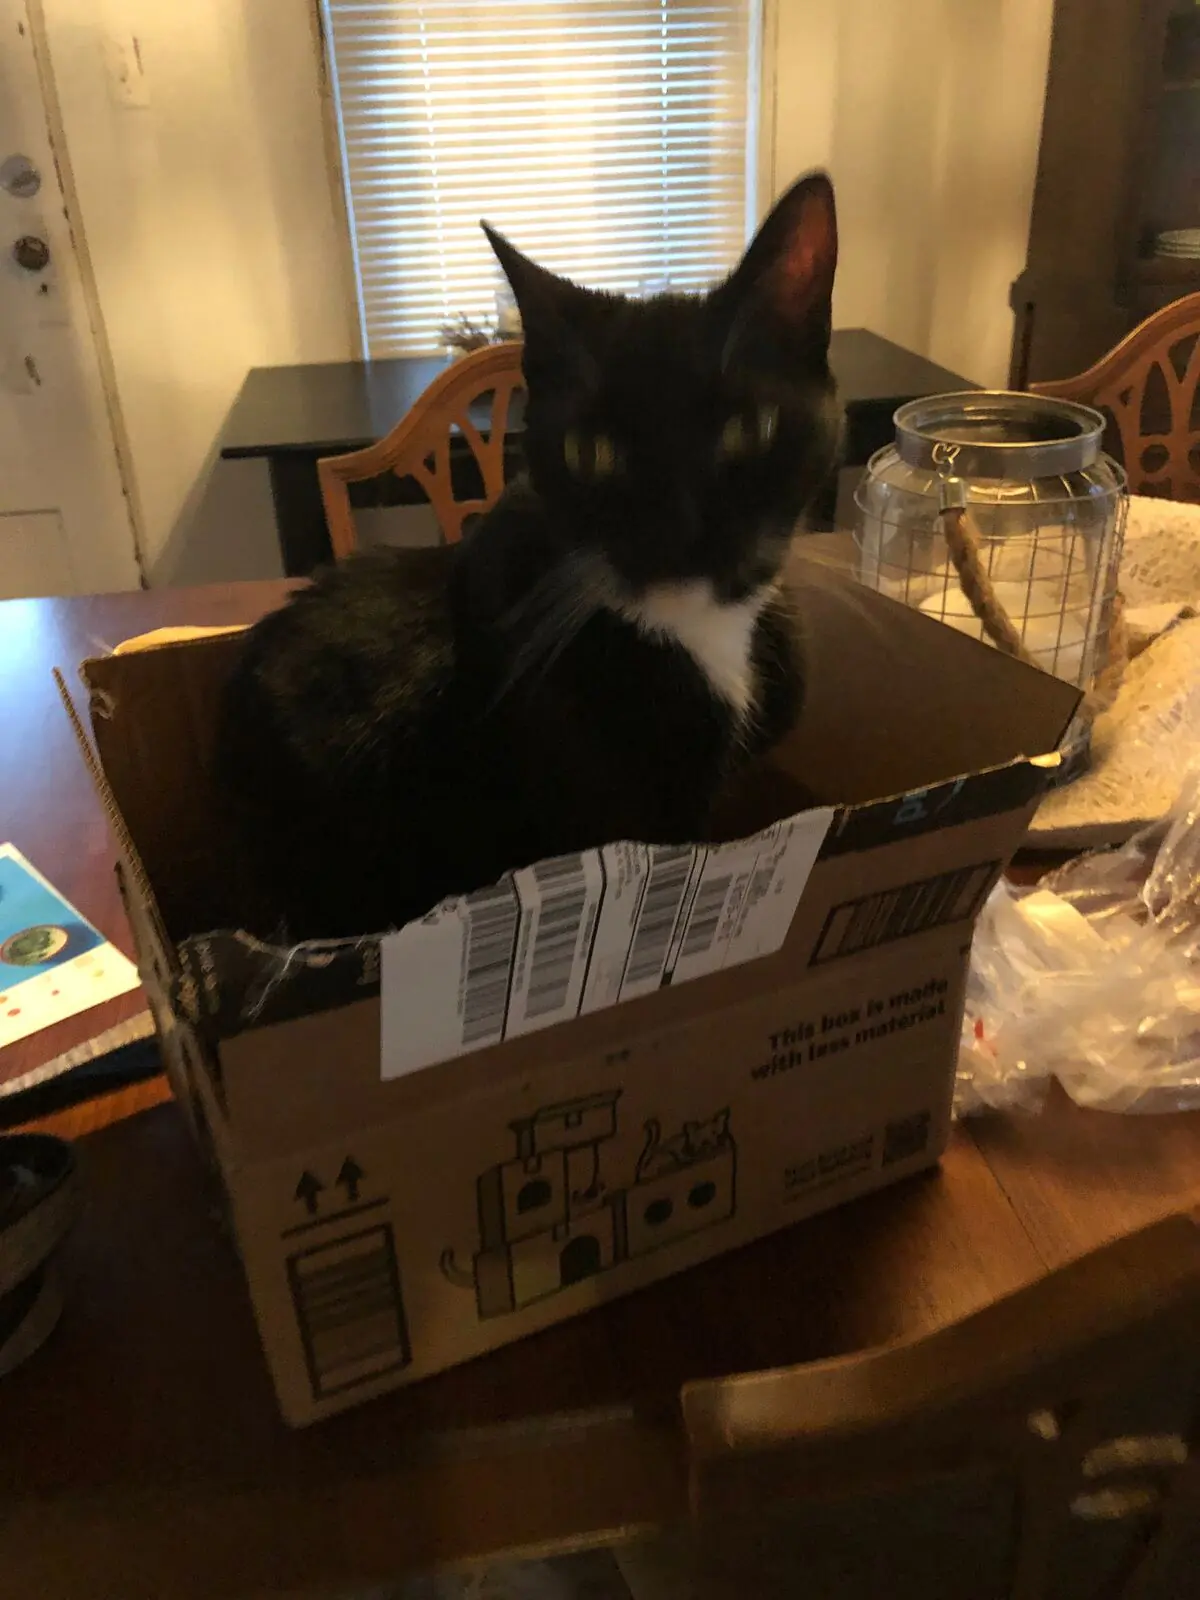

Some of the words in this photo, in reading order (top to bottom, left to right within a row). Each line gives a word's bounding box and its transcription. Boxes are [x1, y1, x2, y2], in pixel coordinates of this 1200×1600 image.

[750, 1049, 802, 1080] with
[809, 1036, 850, 1060] less
[855, 1000, 946, 1043] material
[768, 1022, 815, 1050] This
[822, 1008, 860, 1033] box
[867, 999, 884, 1018] is
[890, 978, 948, 1008] made
